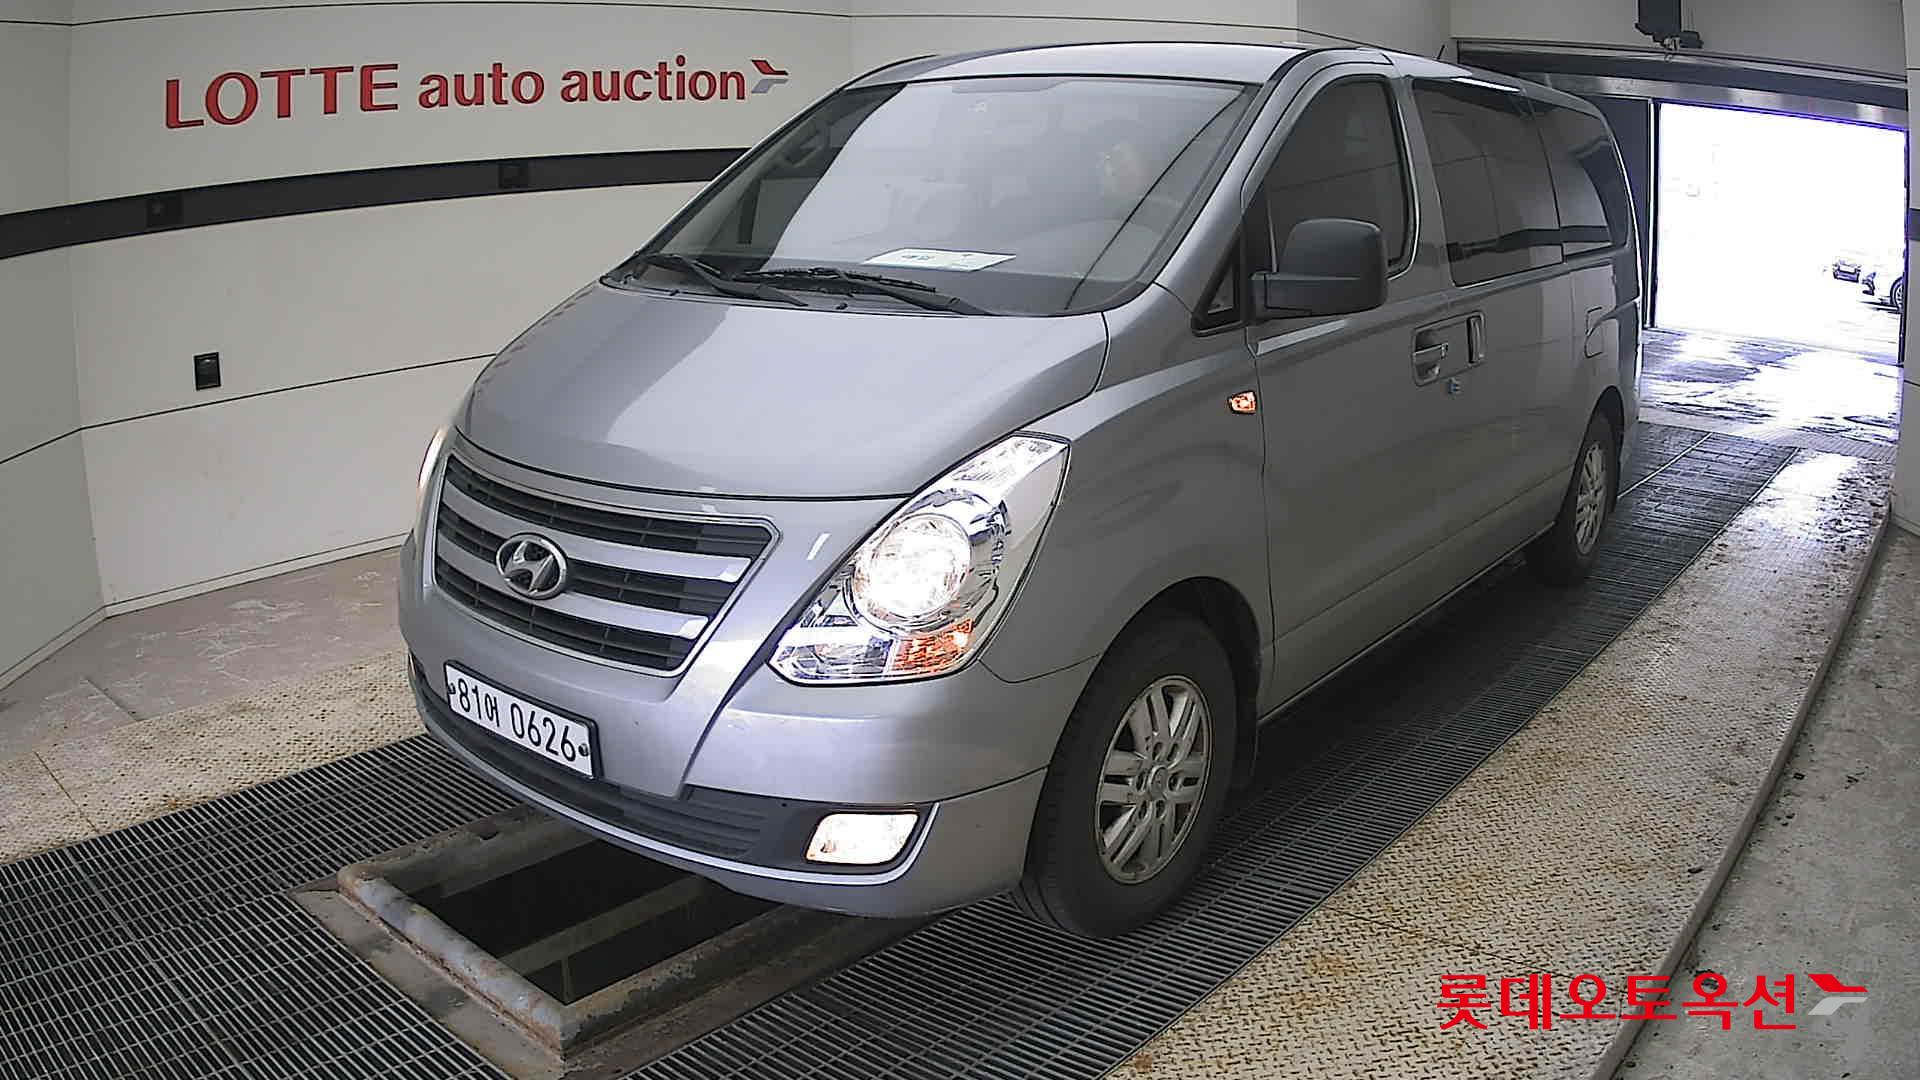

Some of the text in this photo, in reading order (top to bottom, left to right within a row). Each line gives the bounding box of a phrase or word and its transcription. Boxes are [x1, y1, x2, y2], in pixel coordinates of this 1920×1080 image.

[165, 55, 746, 129] LOTTE auto auction
[458, 678, 577, 762] 81어 0626
